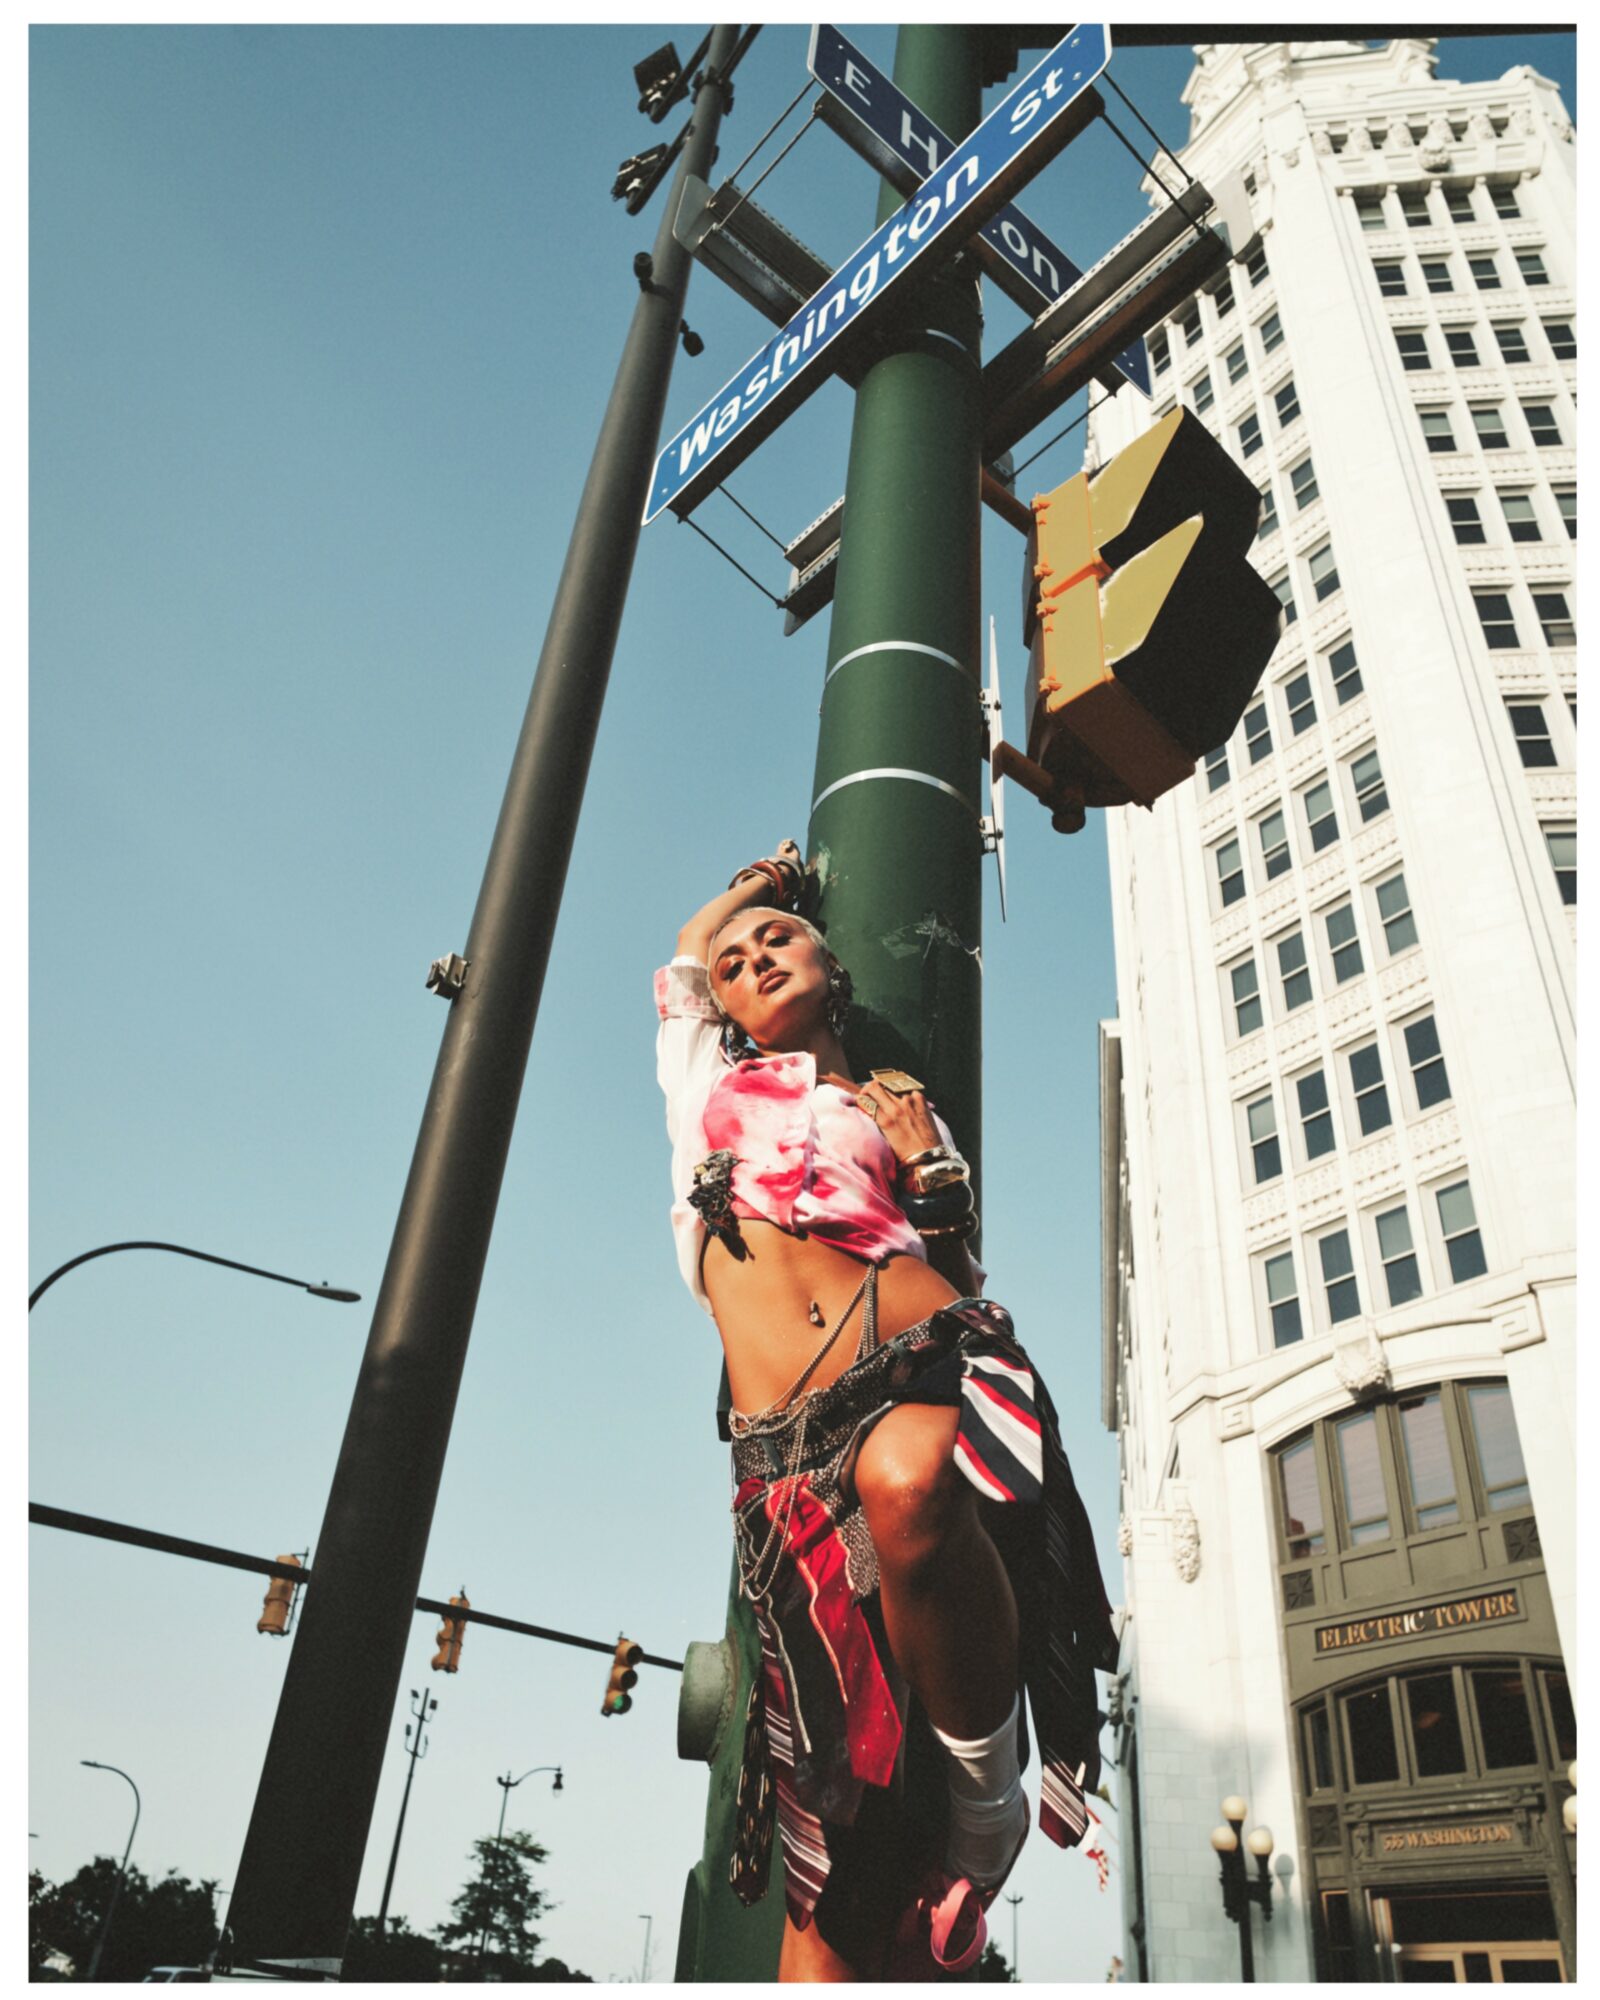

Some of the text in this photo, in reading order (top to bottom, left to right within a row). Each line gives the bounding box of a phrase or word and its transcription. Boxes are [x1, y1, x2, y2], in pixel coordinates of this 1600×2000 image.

[845, 59, 1060, 293] E Hon
[679, 67, 1064, 476] Washington St
[1321, 1593, 1517, 1649] ELECTRIC TOWER
[1407, 1824, 1512, 1848] WASHINGTON
